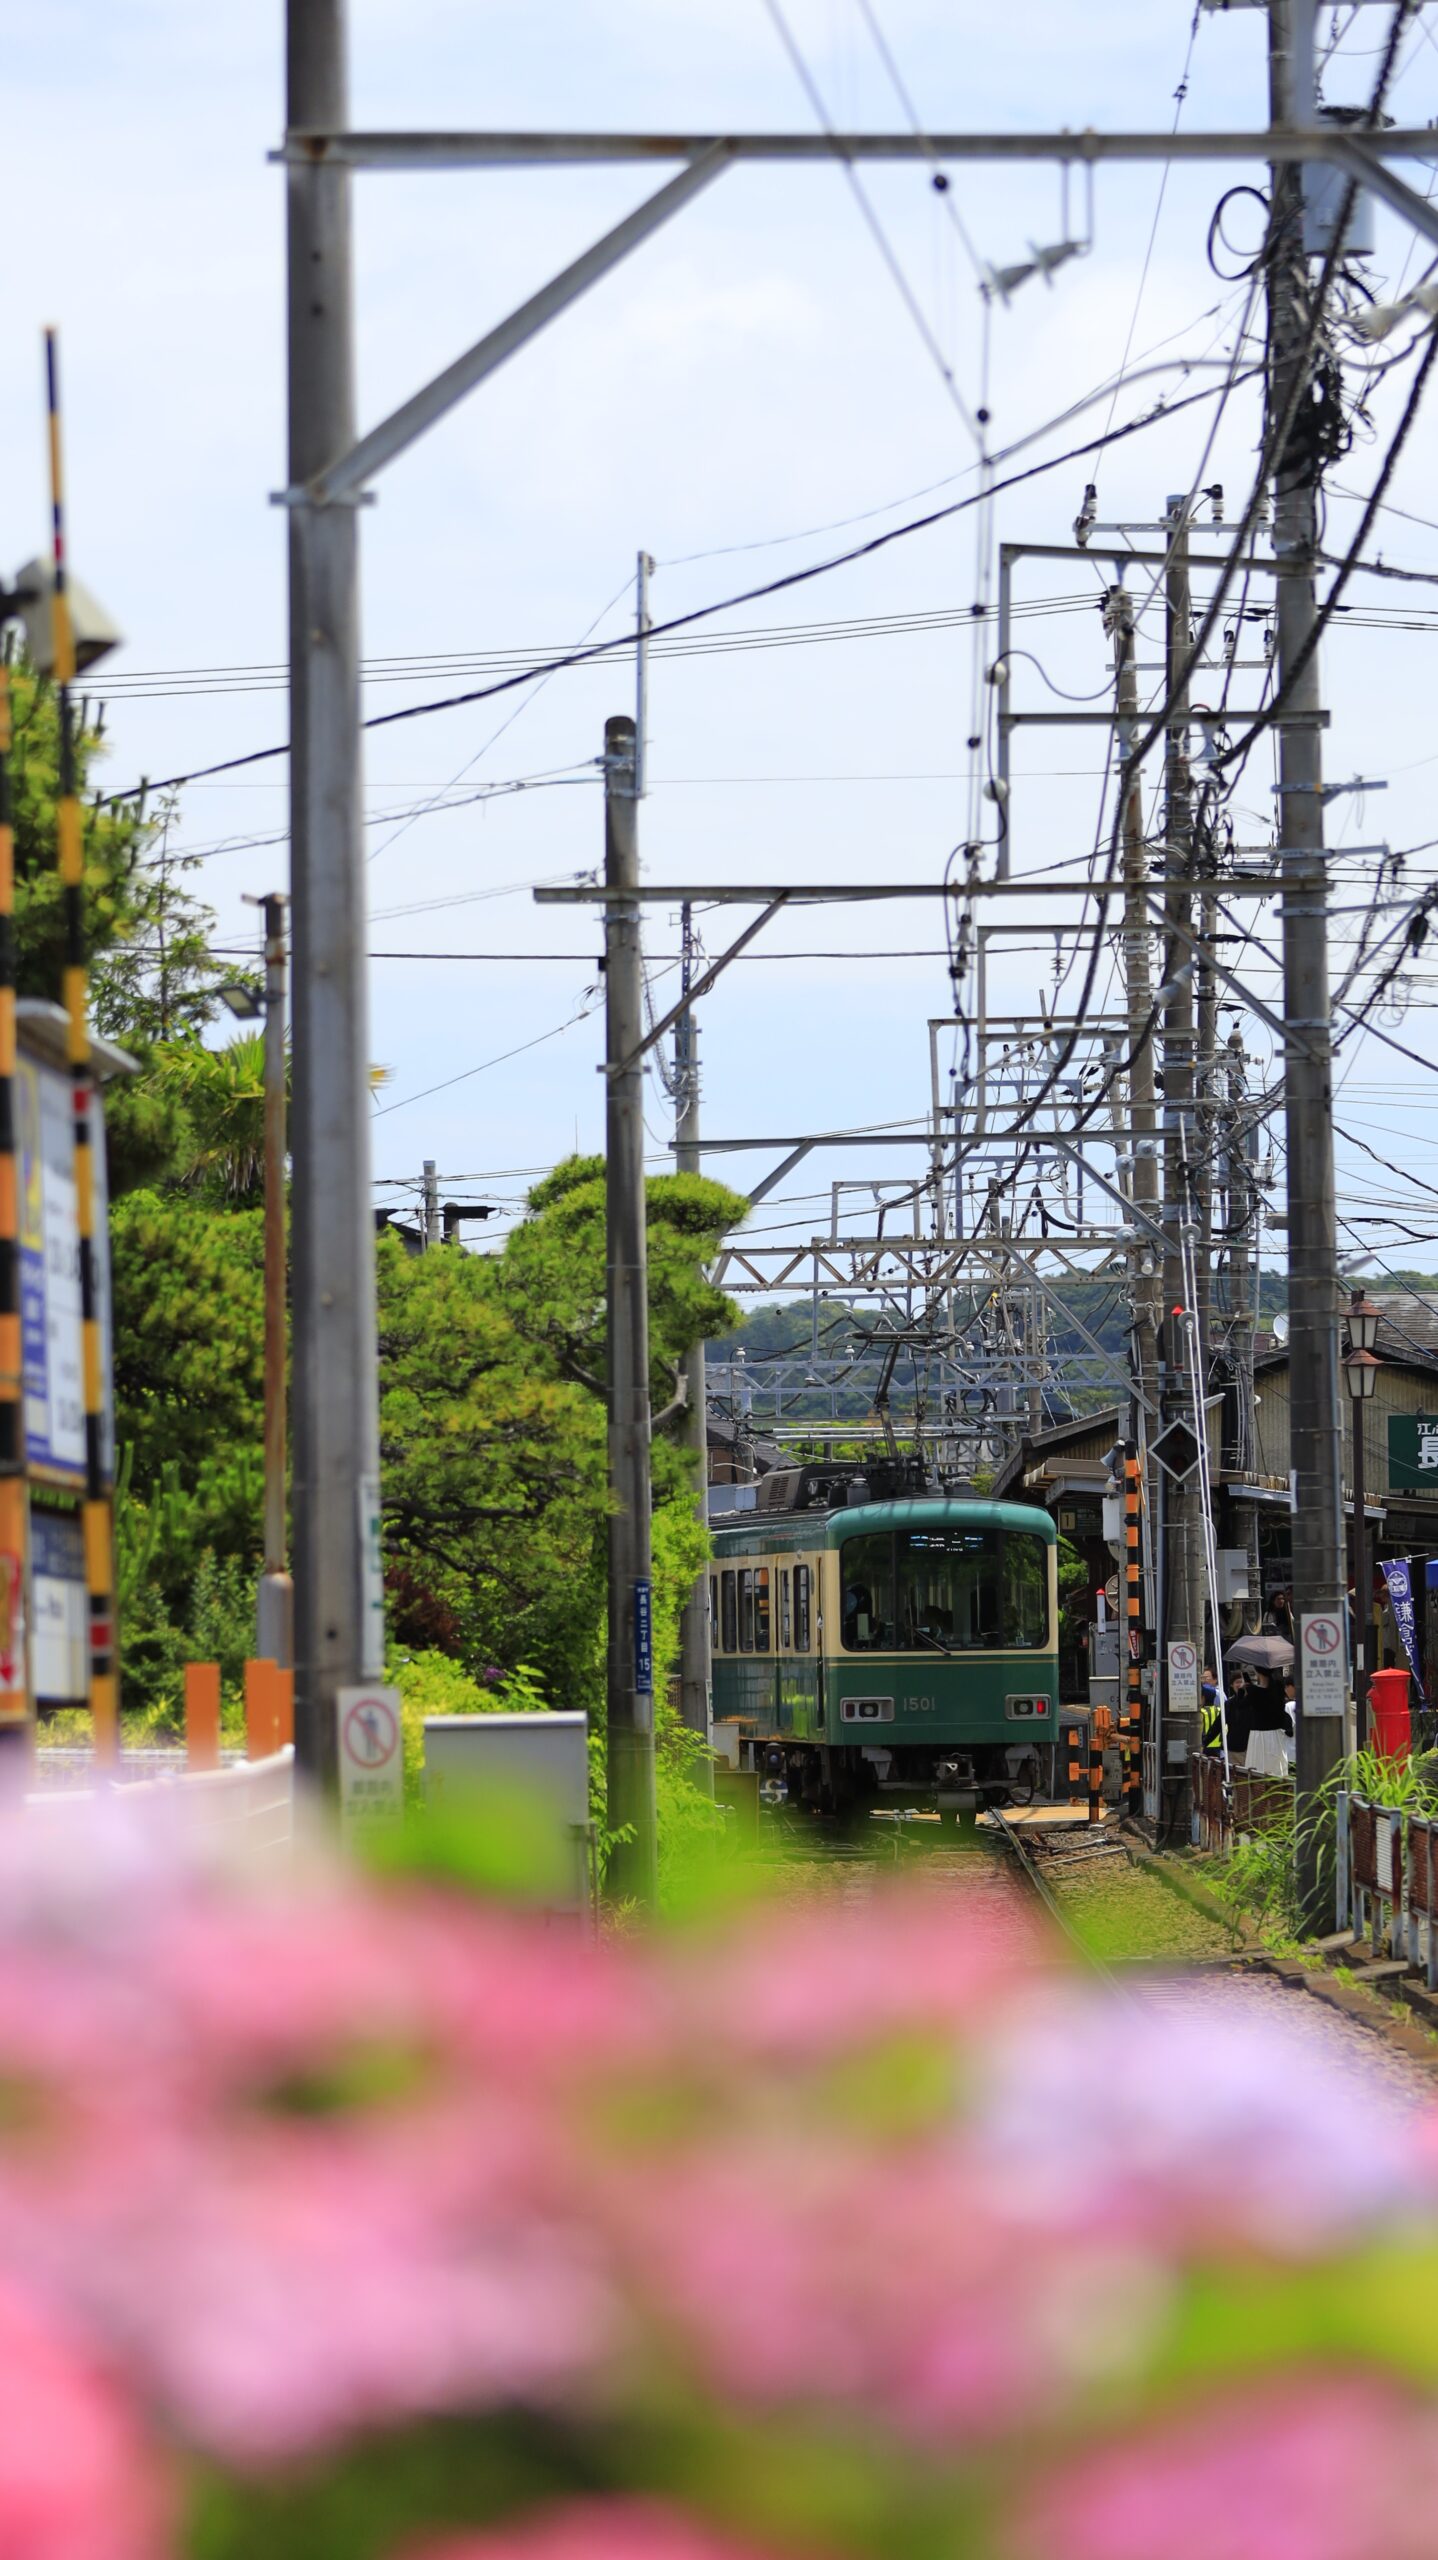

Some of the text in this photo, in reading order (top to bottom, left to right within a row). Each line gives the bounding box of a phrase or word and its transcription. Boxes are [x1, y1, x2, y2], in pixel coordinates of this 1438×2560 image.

[1417, 1423, 1438, 1435] 江ノ
[638, 1658, 651, 1671] 15
[903, 1697, 936, 1711] 1501
